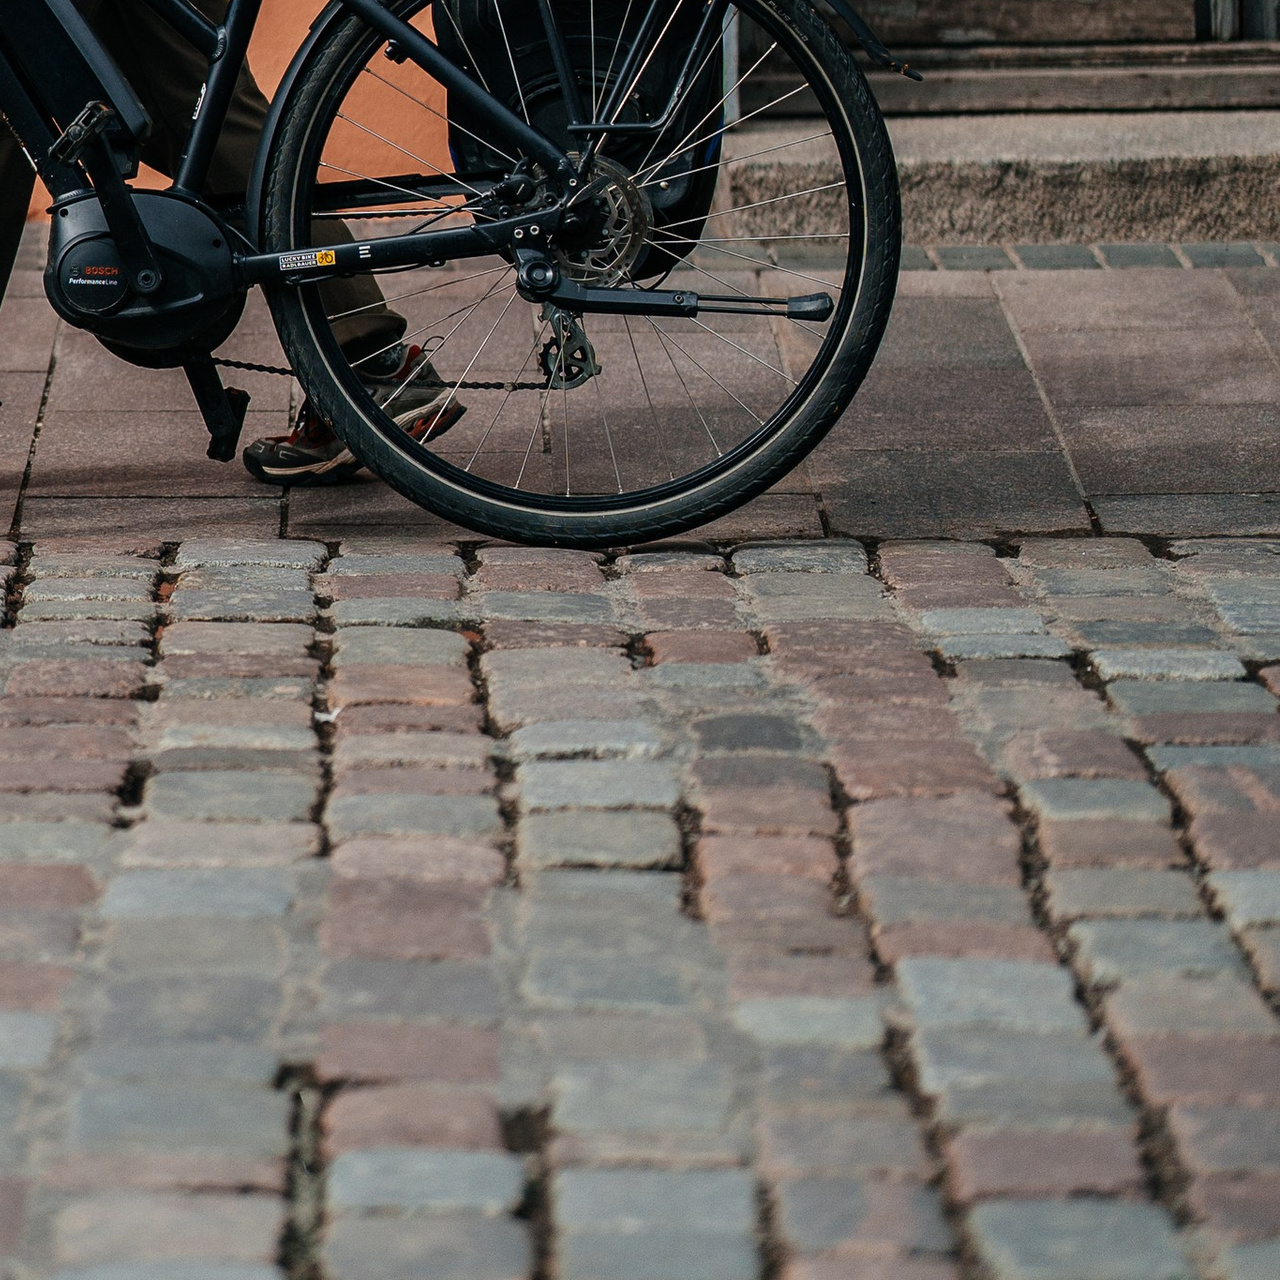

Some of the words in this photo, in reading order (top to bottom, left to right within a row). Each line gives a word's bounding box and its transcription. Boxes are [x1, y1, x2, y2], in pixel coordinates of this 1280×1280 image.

[768, 0, 791, 22] PLUS
[281, 255, 301, 263] LUCKY
[302, 253, 317, 261] BIKE
[85, 266, 118, 275] BOSCH
